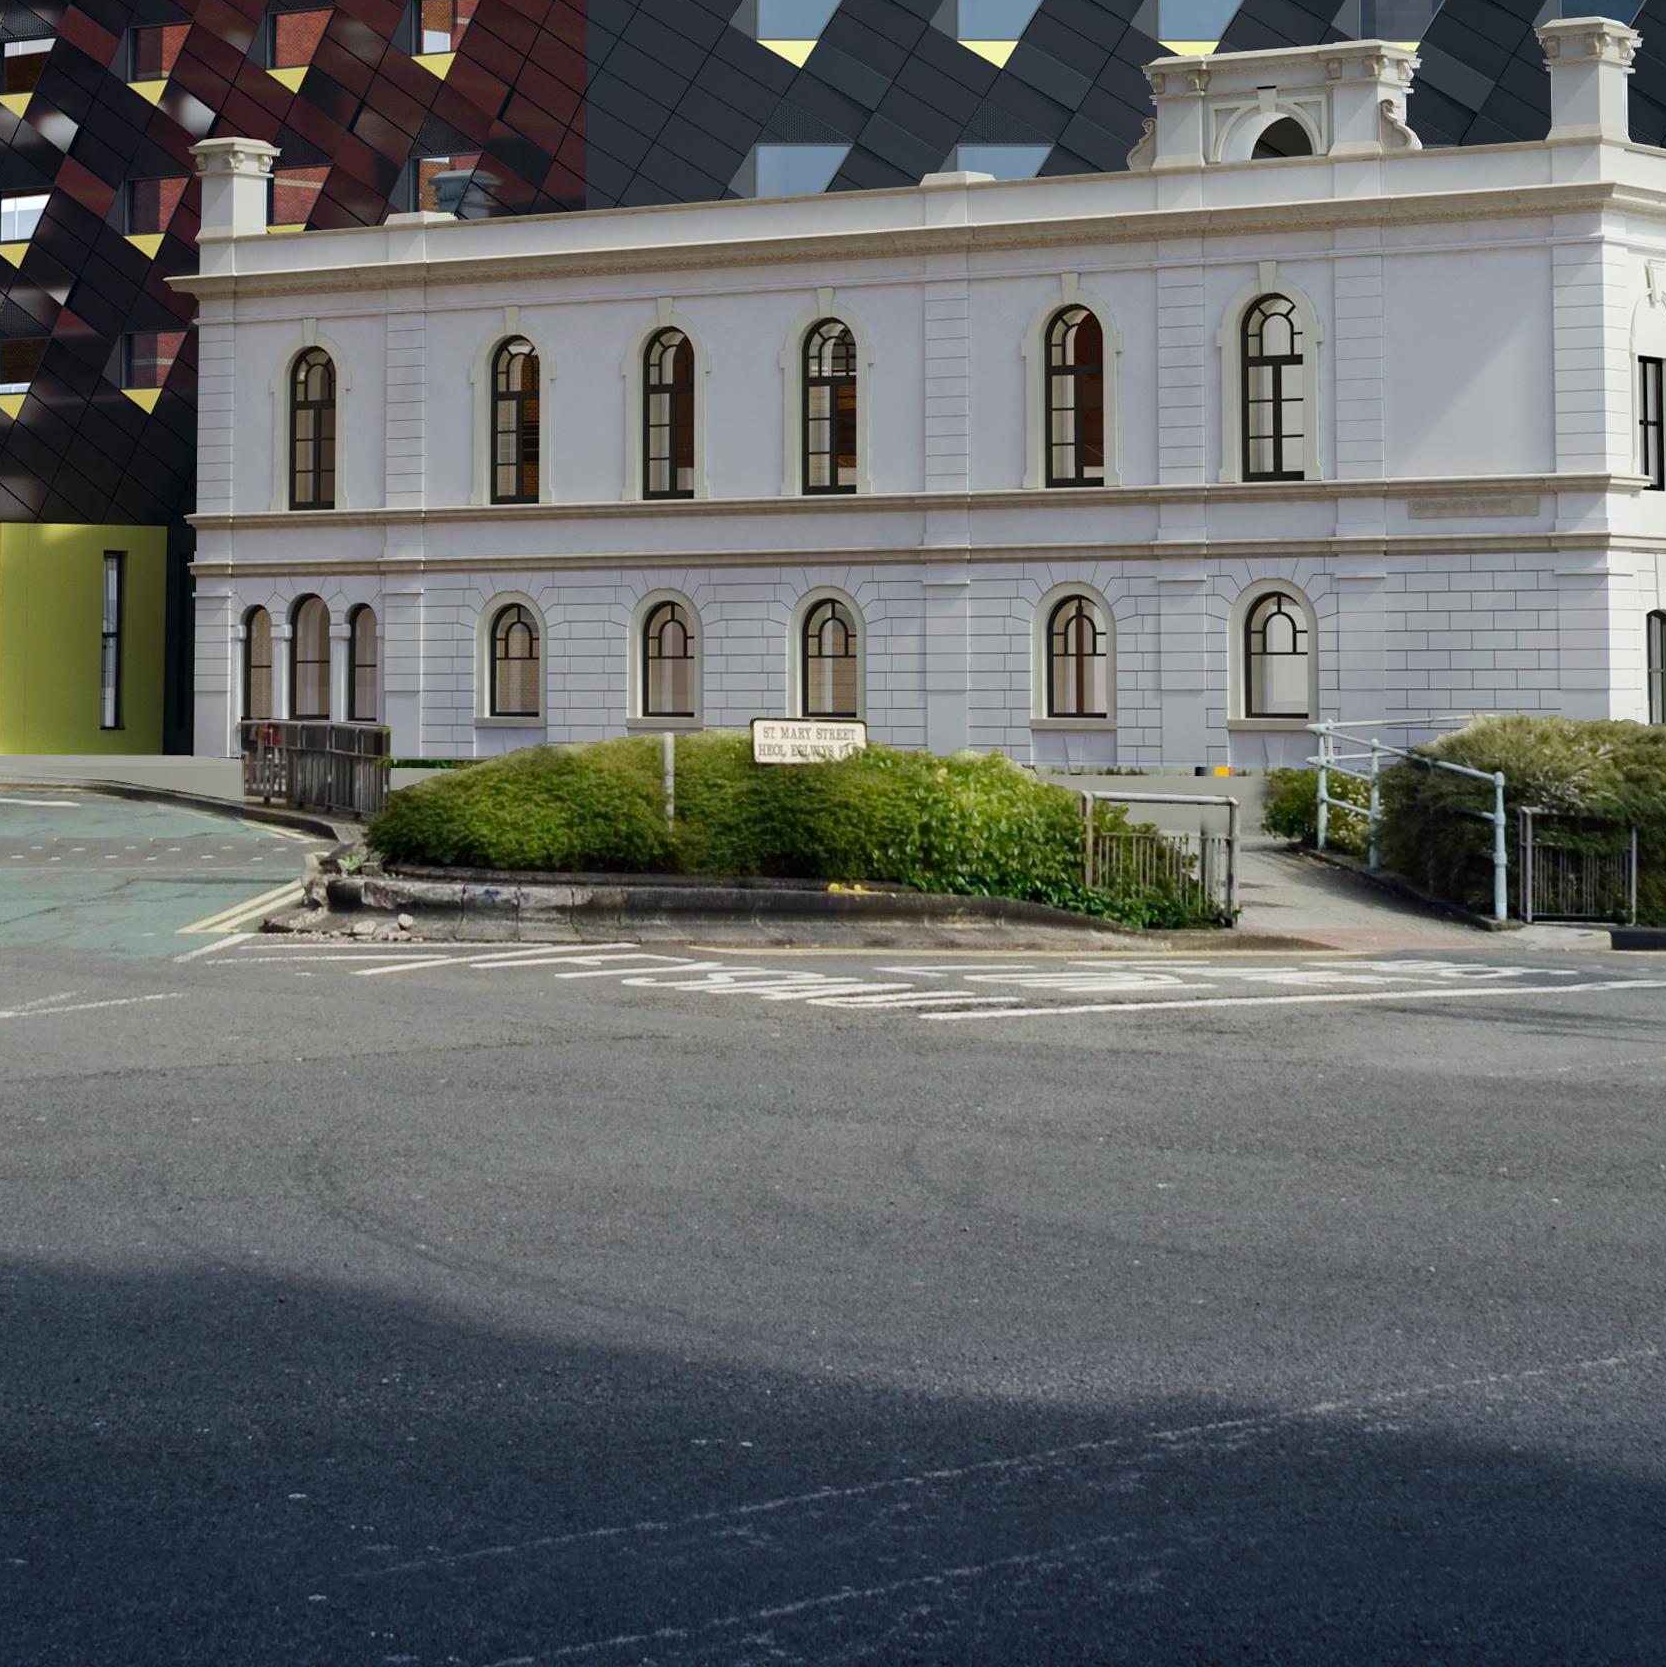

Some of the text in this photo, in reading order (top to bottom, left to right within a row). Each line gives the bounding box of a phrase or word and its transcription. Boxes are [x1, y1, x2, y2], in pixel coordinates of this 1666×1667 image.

[781, 727, 811, 740] MARY
[816, 728, 856, 741] STREET
[758, 744, 787, 757] HEOL
